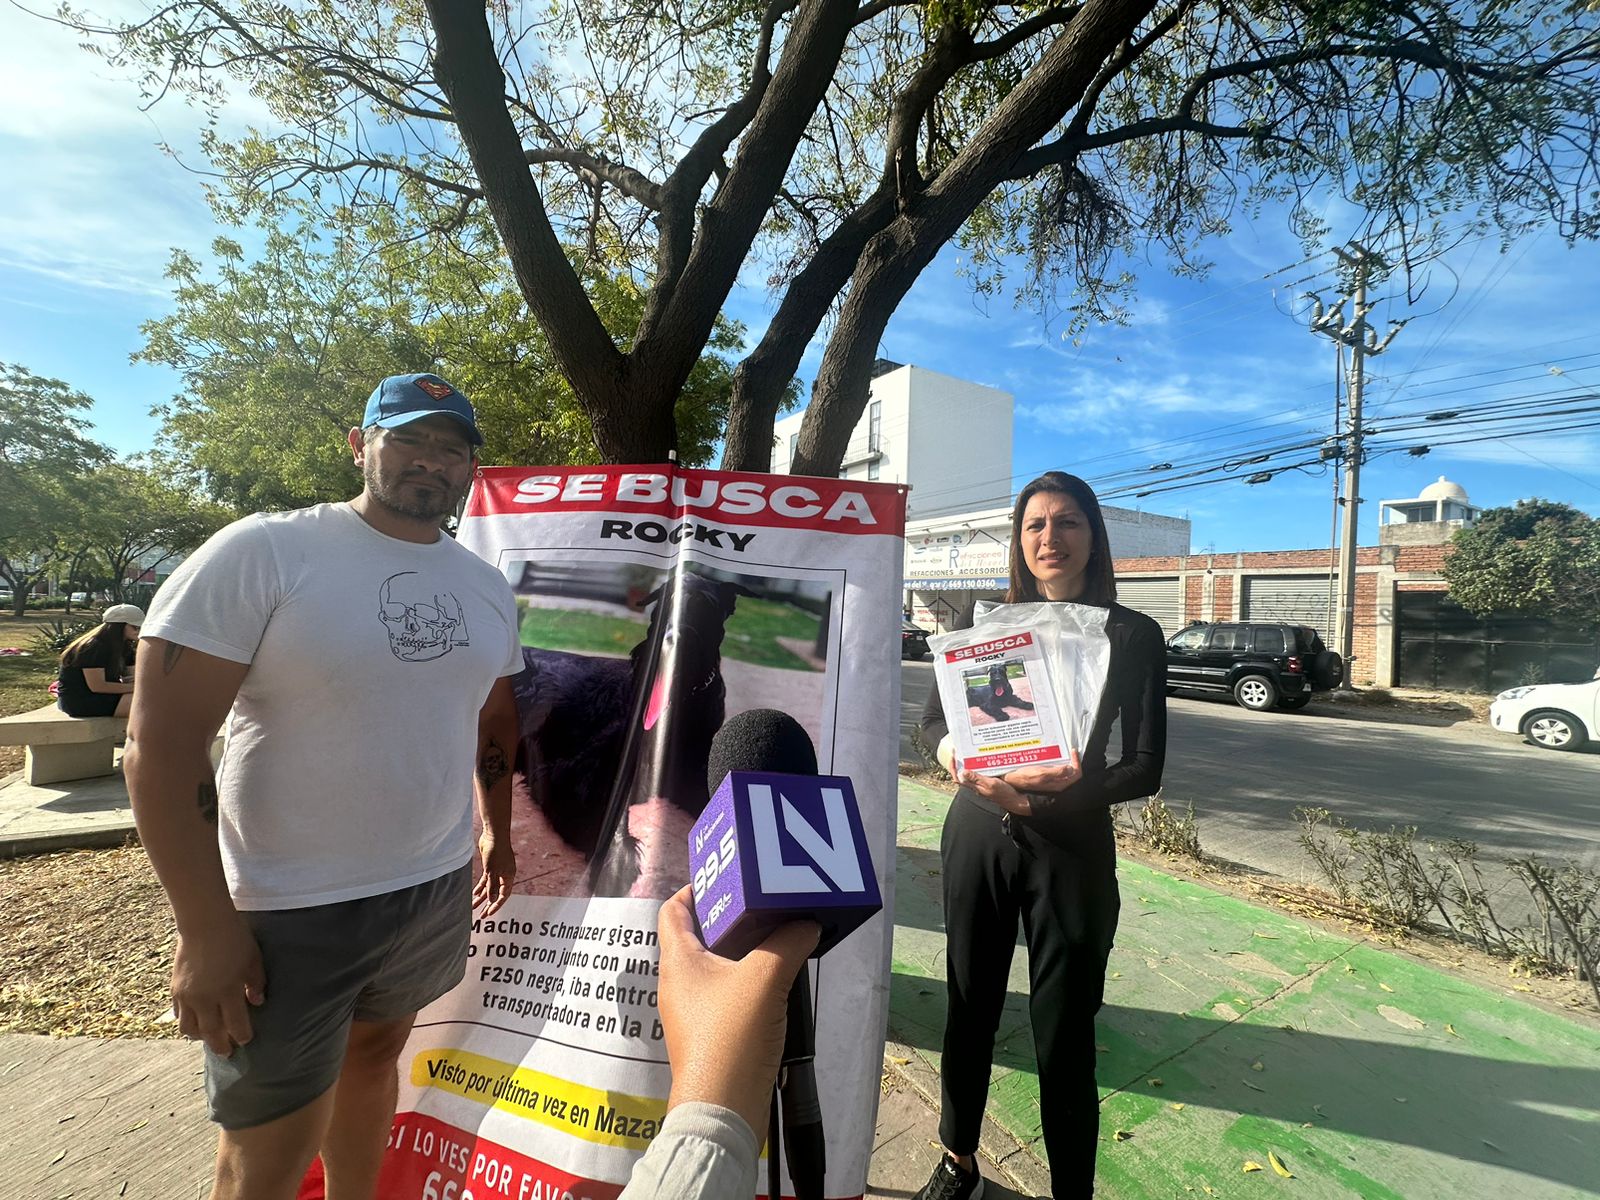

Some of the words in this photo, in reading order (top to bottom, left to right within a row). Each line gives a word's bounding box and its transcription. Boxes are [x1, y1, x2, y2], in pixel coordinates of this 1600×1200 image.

[513, 473, 607, 504] SE
[617, 473, 877, 525] BUSCA
[600, 519, 756, 553] ROCKY
[955, 648, 973, 660] SE
[974, 637, 1027, 655] BUSCA
[975, 652, 1006, 664] ROCKY
[694, 825, 736, 905] 99.5
[539, 921, 607, 942] Schnauzer
[607, 924, 658, 947] gigan
[467, 944, 478, 958] o
[485, 941, 556, 963] robaron
[556, 949, 589, 968] junto
[592, 954, 619, 972] con
[625, 958, 660, 977] una
[480, 966, 524, 985] F250
[526, 973, 565, 996] negra,
[569, 976, 591, 998] iba
[595, 981, 659, 1008] dentro
[482, 991, 590, 1029] transportadora
[596, 1015, 617, 1034] en
[621, 1015, 642, 1038] la
[427, 1059, 466, 1085] Visto
[464, 1072, 493, 1094] por
[492, 1075, 540, 1110] última
[542, 1095, 568, 1120] vez
[570, 1104, 590, 1128] en
[594, 1105, 667, 1140] Mazat
[413, 1128, 434, 1157] LO
[439, 1137, 470, 1173] VES
[472, 1153, 513, 1196] POR
[518, 1173, 593, 1200] FAV
